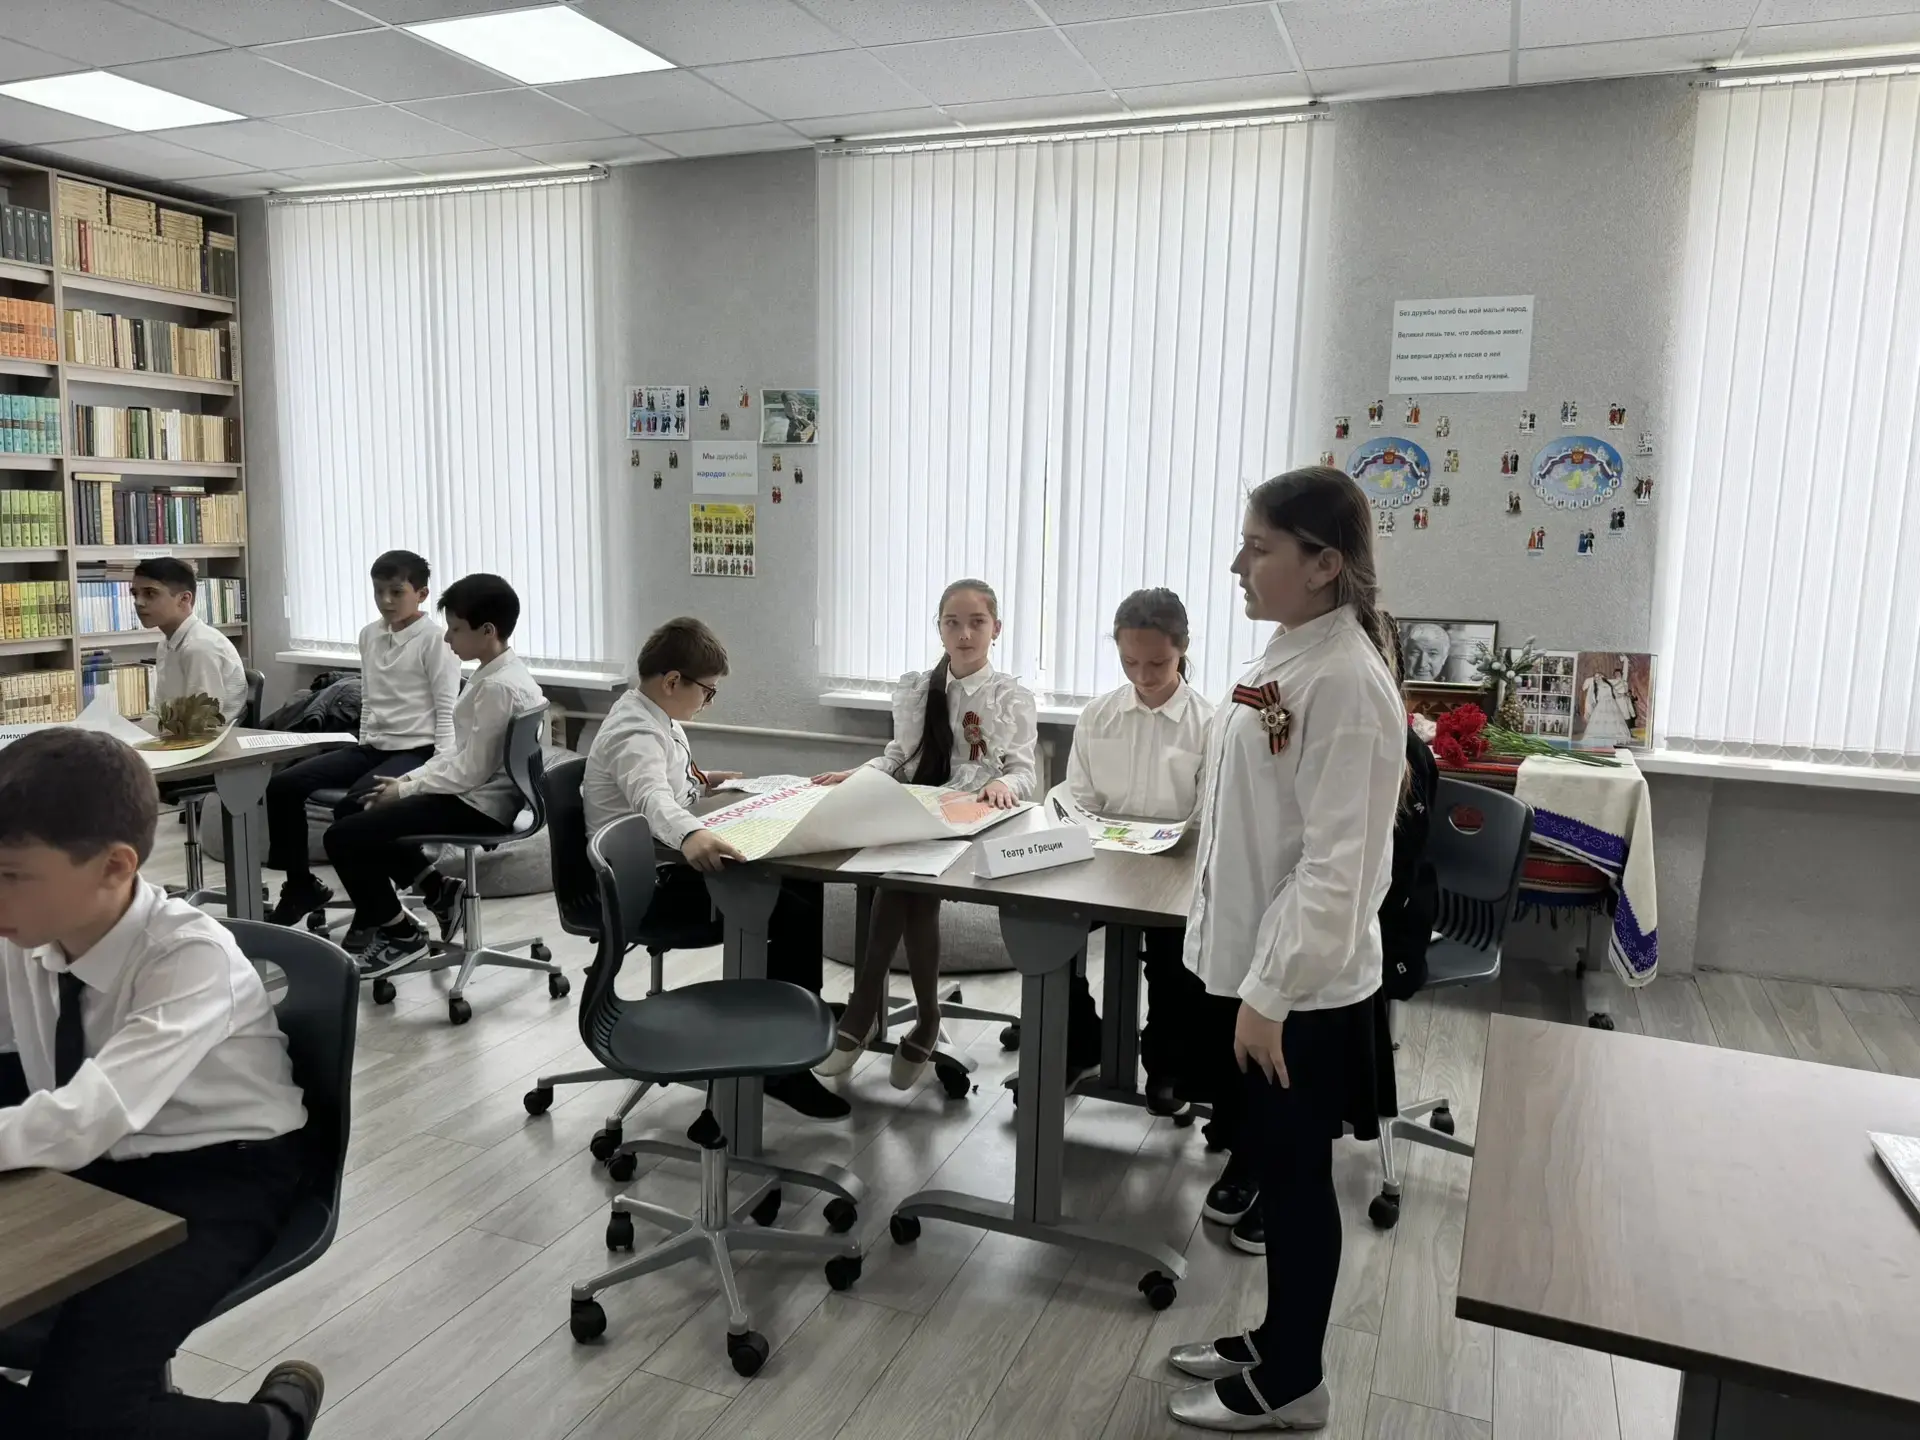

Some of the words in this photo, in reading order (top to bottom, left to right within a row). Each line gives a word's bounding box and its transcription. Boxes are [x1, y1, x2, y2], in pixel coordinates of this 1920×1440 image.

[1411, 309, 1436, 318] дружбы
[1471, 328, 1501, 336] любовью
[1433, 350, 1457, 360] дружба
[702, 452, 715, 460] Мы
[716, 451, 748, 463] дружбой
[696, 471, 727, 479] народов
[1001, 847, 1025, 859] Театр
[1028, 846, 1033, 855] в
[1034, 841, 1064, 854] Греции
